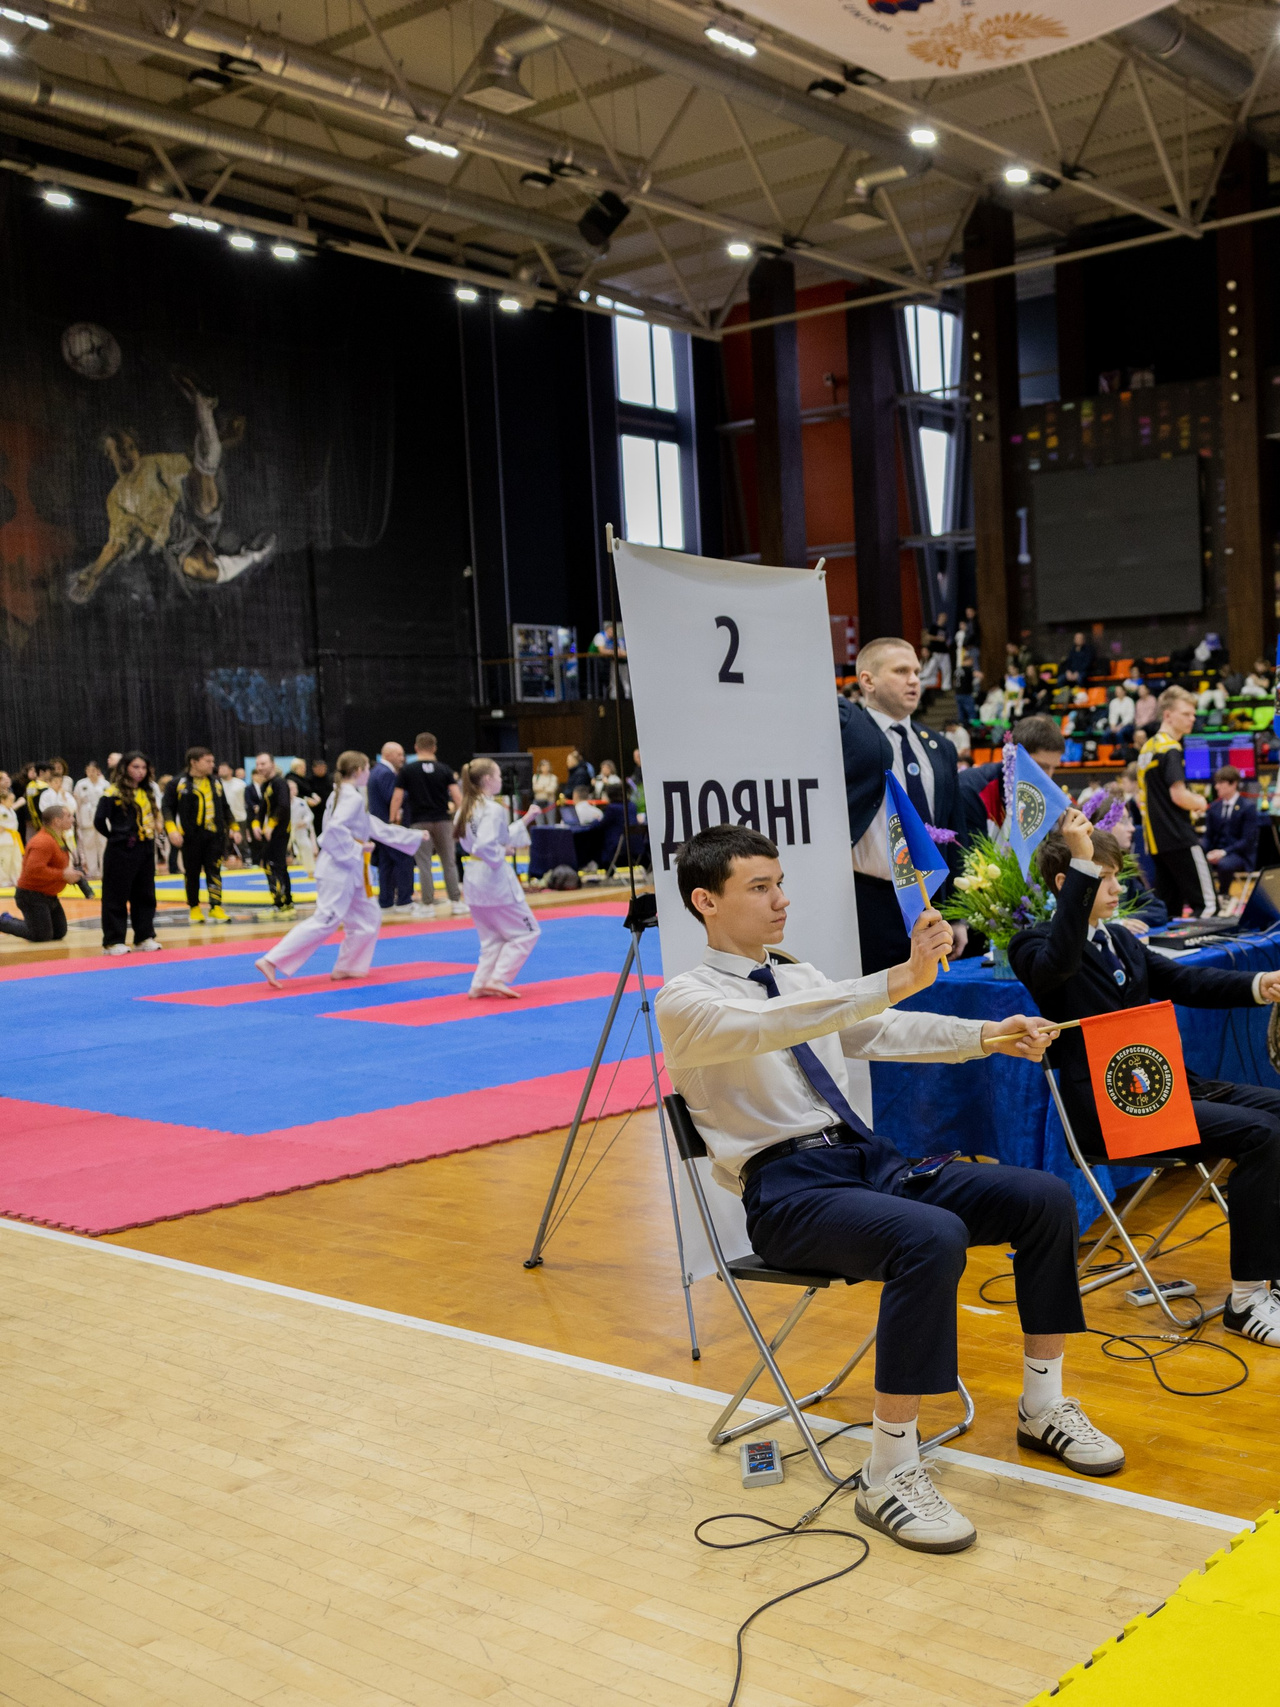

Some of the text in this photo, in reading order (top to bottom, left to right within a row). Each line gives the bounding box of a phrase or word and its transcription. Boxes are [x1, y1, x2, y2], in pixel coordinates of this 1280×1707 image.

[714, 615, 745, 684] 2
[661, 778, 819, 871] ДОЯНГ
[1106, 1069, 1118, 1102] ЧАНГ-ХОН
[1115, 1046, 1173, 1115] ВСЕРОССИЙСКАЯ ФЕДЕРАЦИЯ ТХЭКВОНДО
